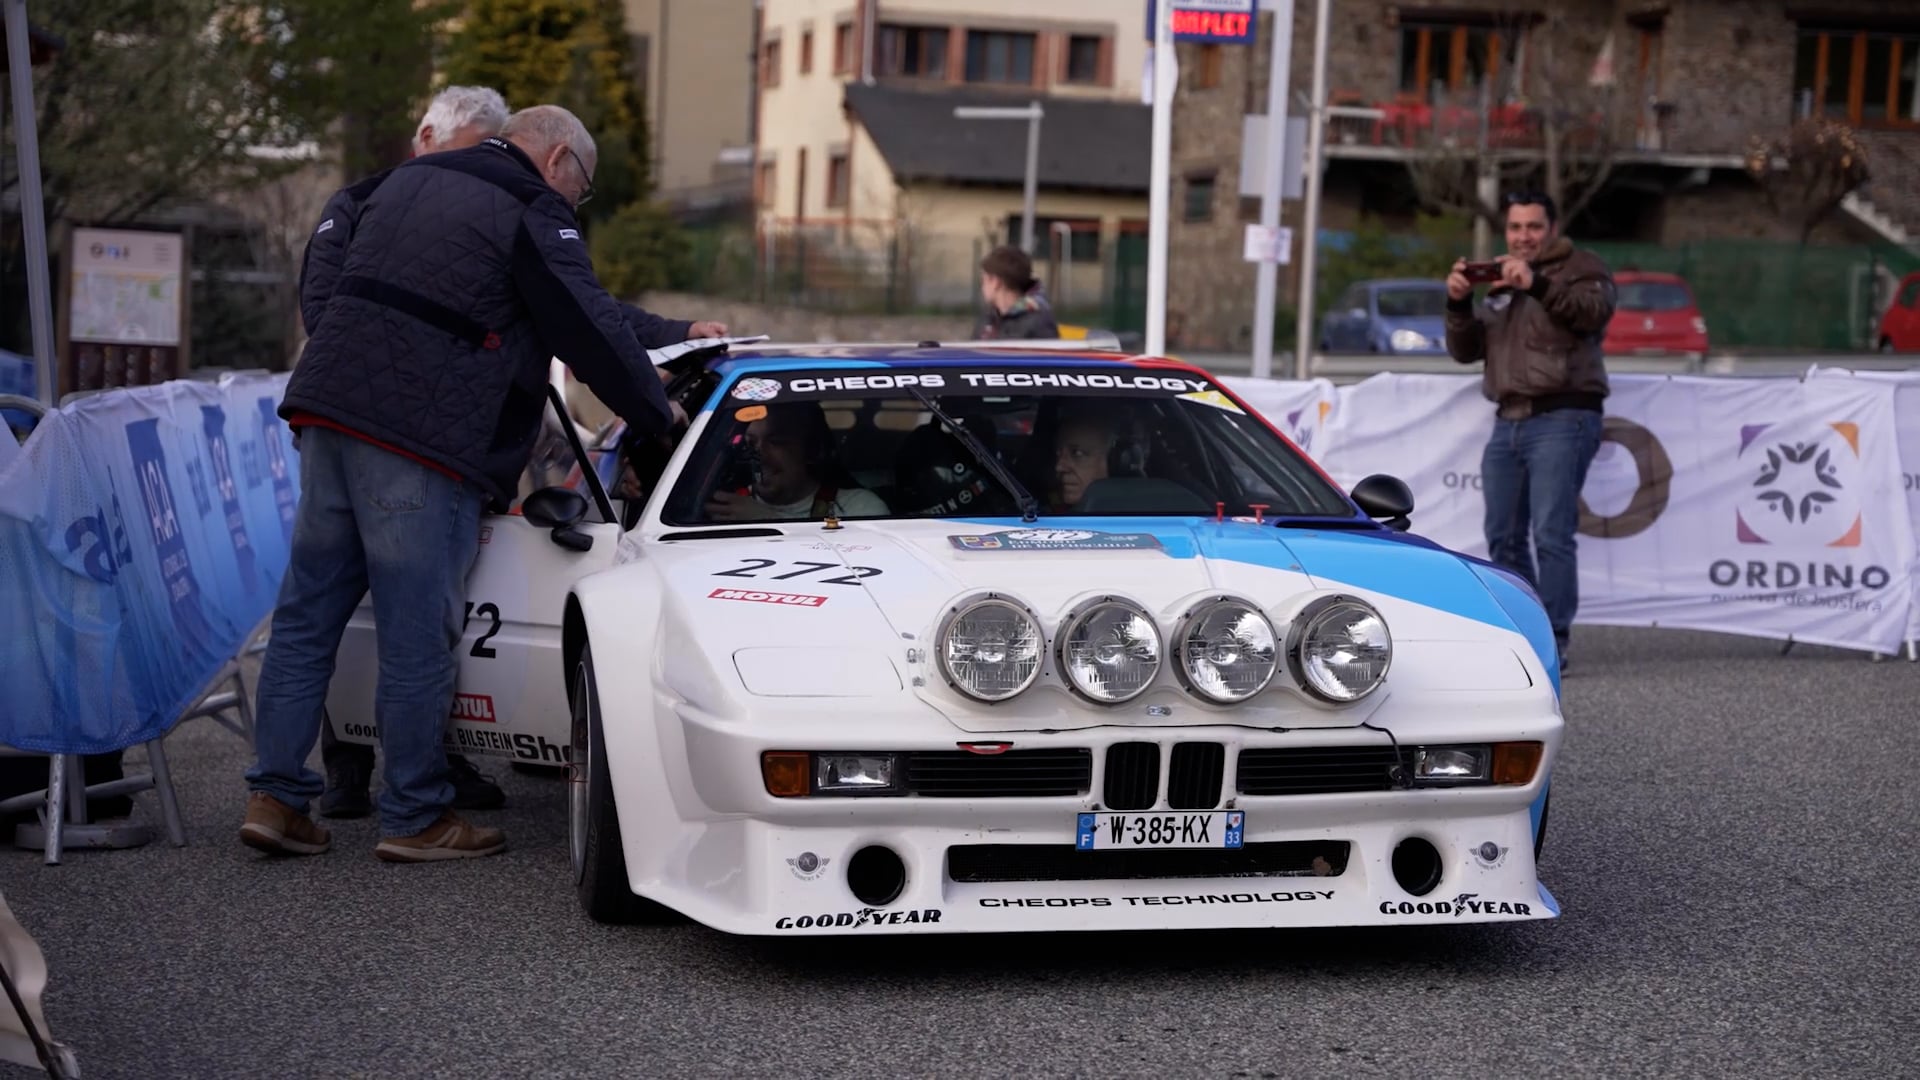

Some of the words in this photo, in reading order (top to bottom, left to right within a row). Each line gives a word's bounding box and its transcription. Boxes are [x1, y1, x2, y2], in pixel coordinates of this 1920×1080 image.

[790, 374, 946, 392] CHEOPS
[960, 373, 1208, 392] TECHNOLOGY
[711, 558, 883, 586] 272
[1709, 559, 1891, 589] ORDINO
[713, 590, 824, 606] MOTUL
[457, 728, 513, 751] BILSTEIN
[1110, 815, 1212, 845] W-385-KX
[1226, 831, 1240, 844] 33
[1081, 834, 1090, 846] F
[979, 897, 1112, 908] CHEOPS
[1122, 890, 1335, 906] TECHNOLOGY
